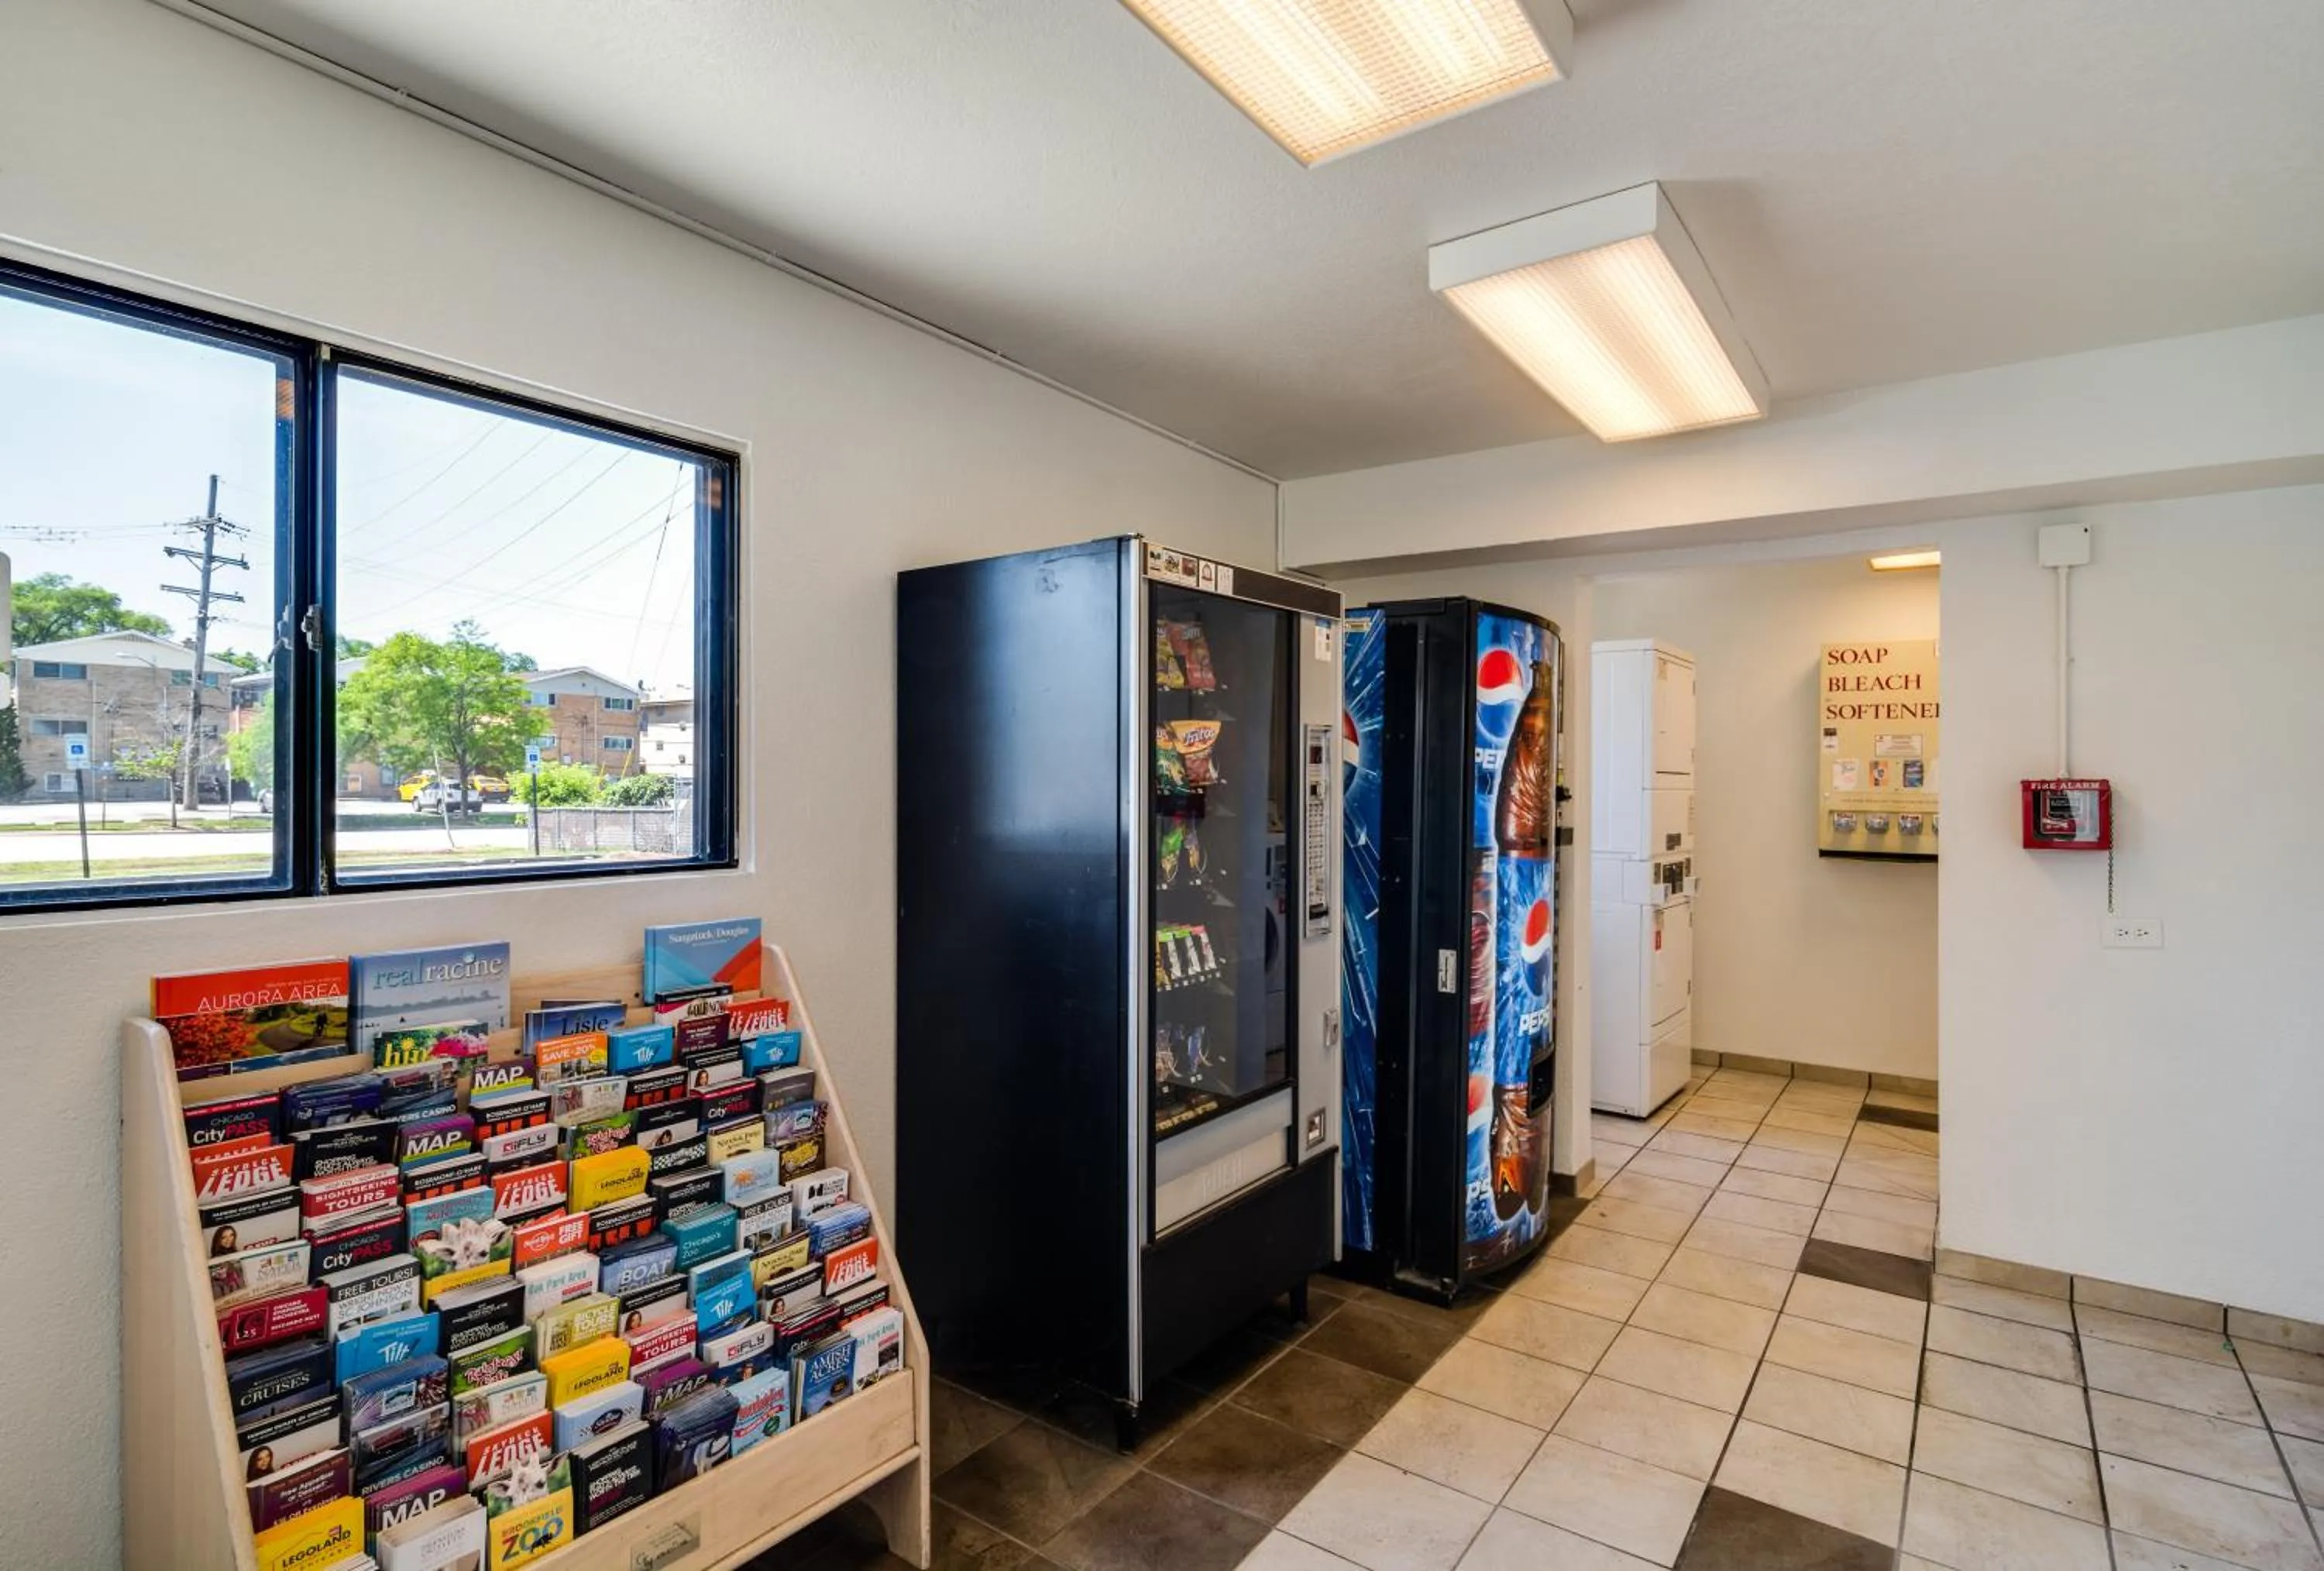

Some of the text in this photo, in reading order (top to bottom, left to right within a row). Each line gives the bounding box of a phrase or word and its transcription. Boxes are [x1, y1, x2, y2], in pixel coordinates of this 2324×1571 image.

[1827, 648, 1888, 665] SOAP
[1828, 674, 1921, 692] BLEACH
[1826, 703, 1939, 720] SOFTENE
[198, 983, 341, 1012] AURORA AREA
[562, 1015, 609, 1036] Lisle
[475, 1066, 524, 1088] MAP
[211, 1112, 256, 1126] CHICAGO
[421, 1104, 456, 1118] CASINO
[406, 1130, 462, 1157] MAP
[315, 1177, 397, 1203] SIGHTSEEING
[325, 1190, 386, 1213] TOURS
[559, 1220, 583, 1235] FREE
[339, 1234, 380, 1251] CHICAGO
[323, 1240, 393, 1270] CityPASS
[621, 1259, 670, 1284] BOAT
[338, 1283, 366, 1301] FREE
[642, 1334, 689, 1359] TOURS
[240, 1373, 310, 1408] CRUISES
[662, 1374, 708, 1401] MAP
[403, 1456, 445, 1478] CASINO
[382, 1488, 446, 1531] MAP
[283, 1530, 351, 1568] LEGOLAND
[502, 1515, 565, 1562] ZOO
